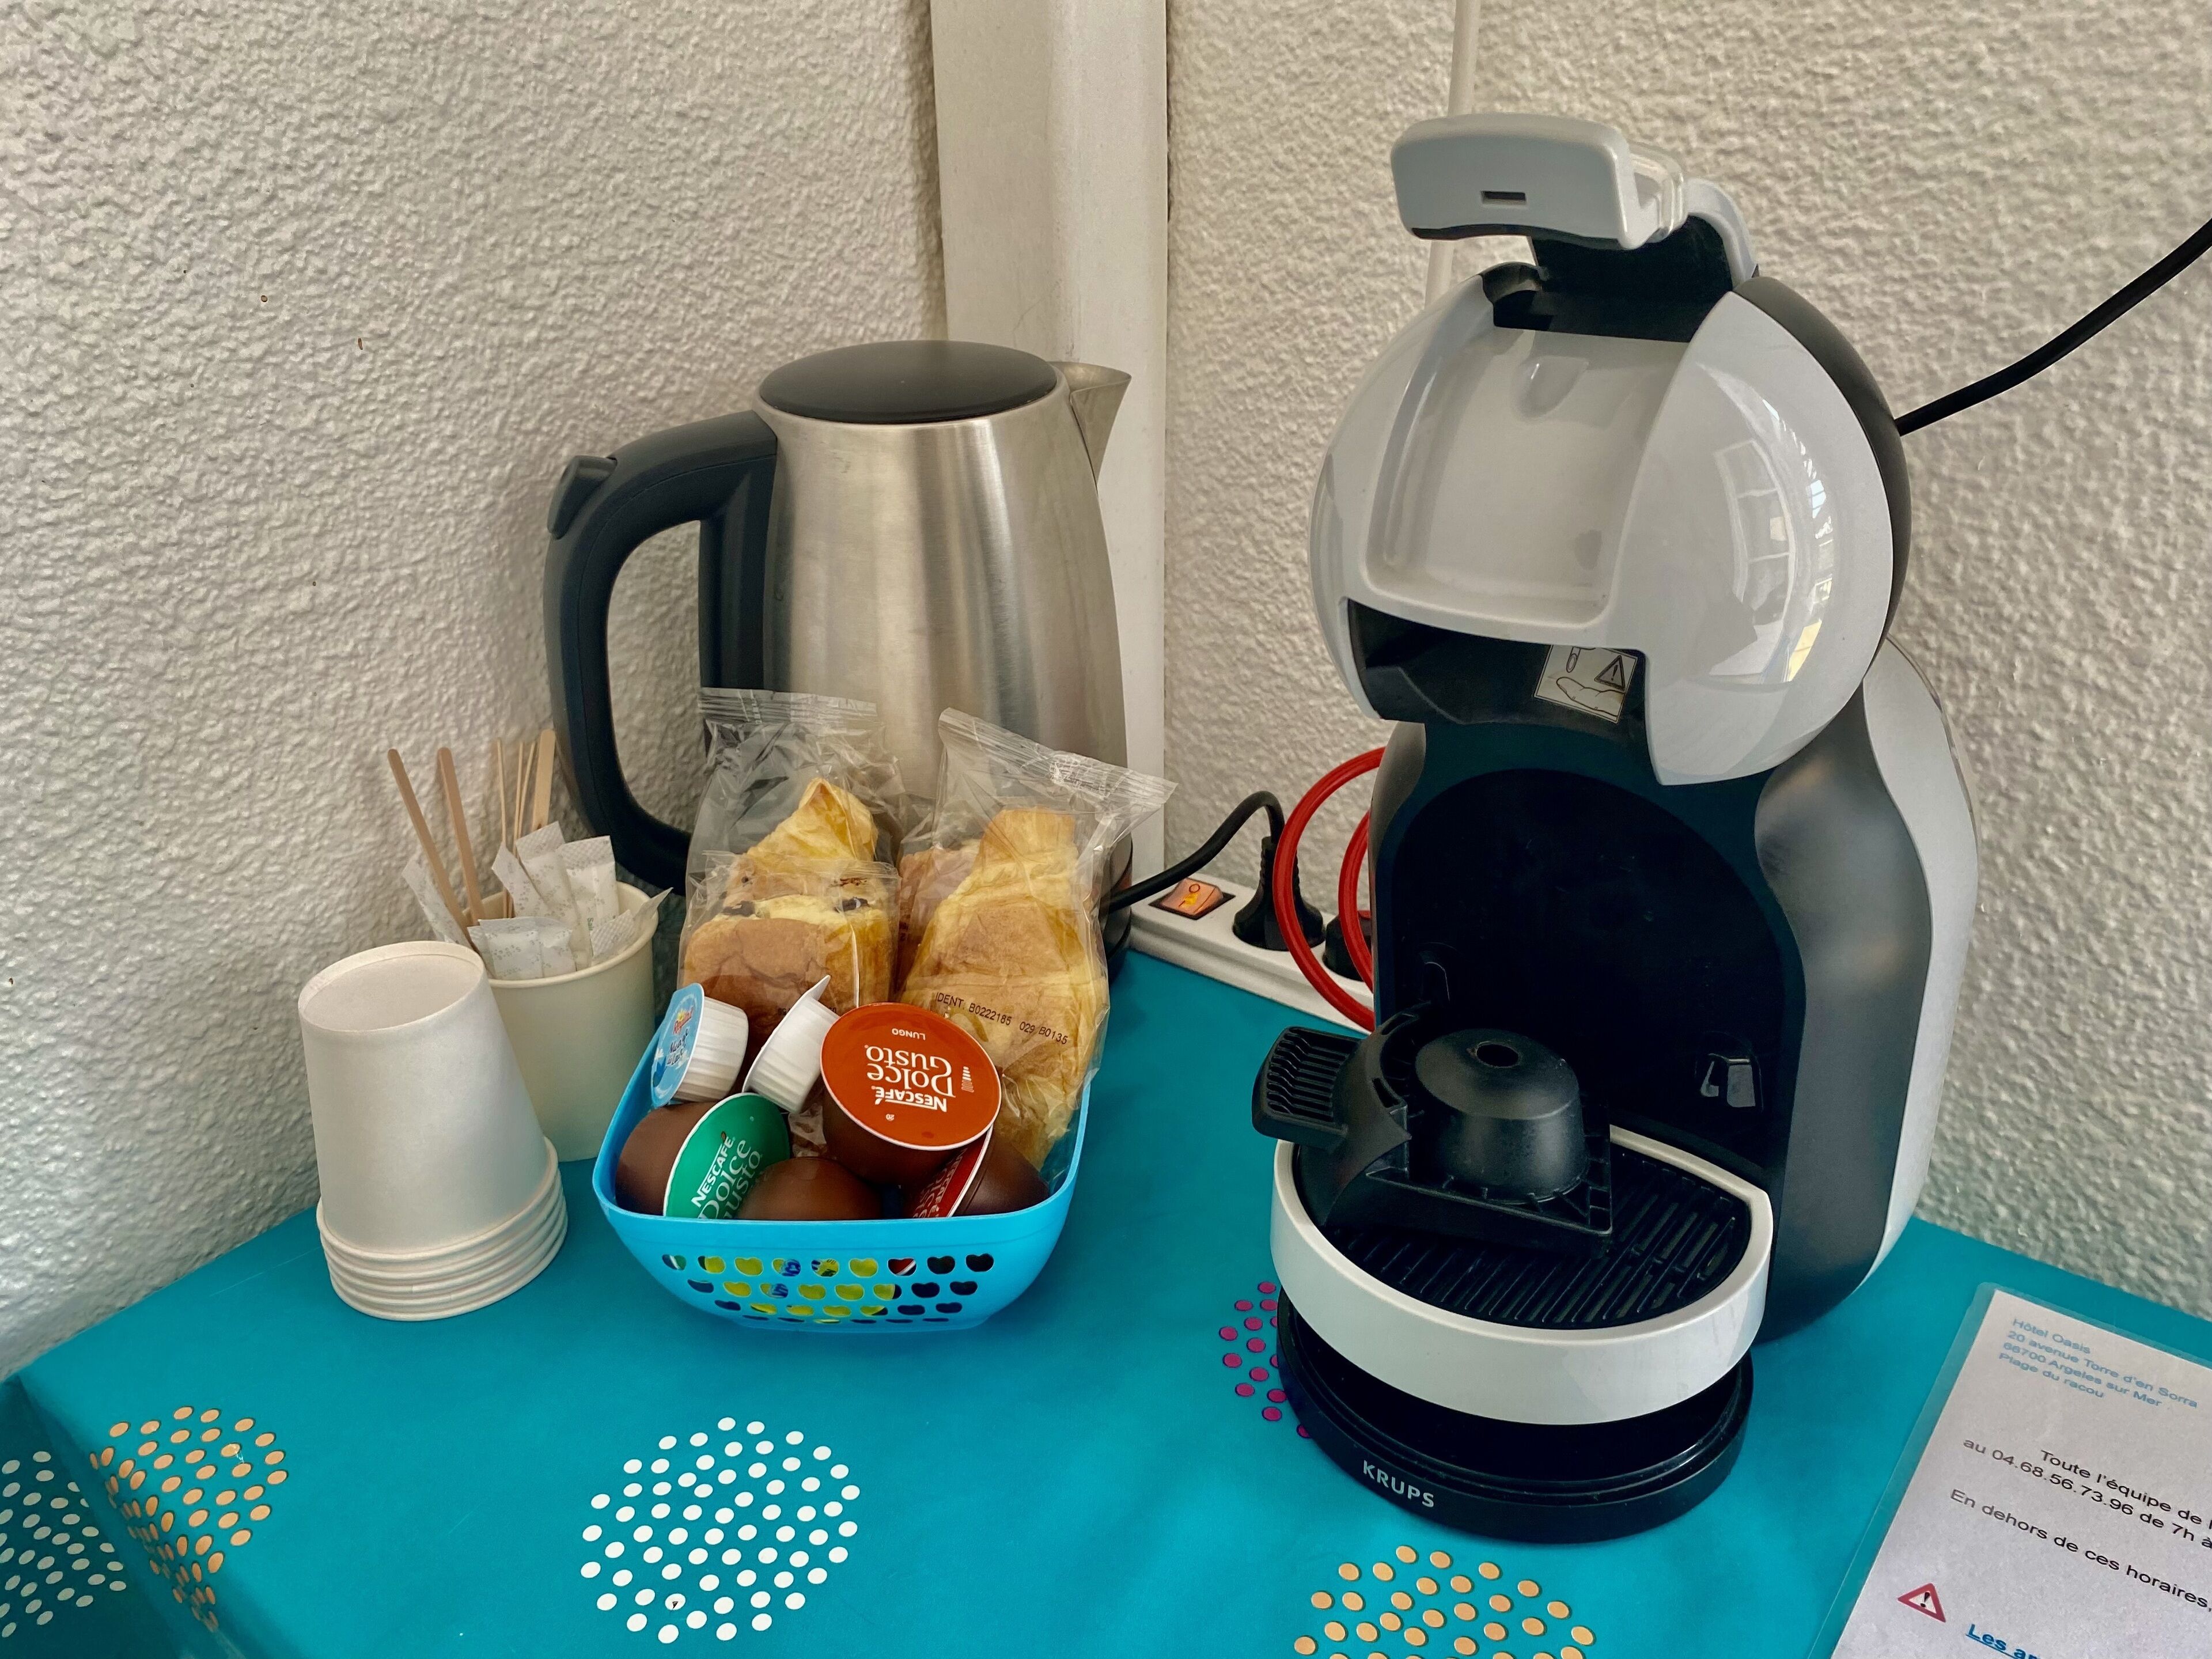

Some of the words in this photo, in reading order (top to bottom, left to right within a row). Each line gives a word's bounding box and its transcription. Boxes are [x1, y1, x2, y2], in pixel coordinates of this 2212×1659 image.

[892, 1028, 926, 1040] LUNGO
[968, 1002, 1012, 1026] B0222185
[1019, 1021, 1036, 1033] 029
[1039, 1027, 1069, 1045] B0135
[865, 1046, 952, 1077] Gusto
[867, 1063, 956, 1098] Dolce
[874, 1086, 947, 1112] NESCAFÉ
[723, 1151, 760, 1218] usto
[2013, 1319, 2048, 1338] Hôtel
[2052, 1334, 2090, 1354] Oasis
[1999, 1353, 2038, 1372] Plage
[2043, 1370, 2060, 1381] du
[2064, 1379, 2104, 1397] racou
[2003, 1342, 2046, 1363] 66700
[2106, 1382, 2130, 1394] sur
[2133, 1391, 2162, 1406] Mer
[2008, 1331, 2025, 1343] 20
[2029, 1340, 2078, 1363] avenue
[2084, 1358, 2119, 1377] Torre
[2158, 1387, 2198, 1408] Sorra
[1363, 1460, 1434, 1508] KRUPS
[1963, 1440, 1986, 1453] au
[1993, 1450, 2134, 1515] 04.68.56.73.96
[2140, 1513, 2164, 1528] de
[2172, 1522, 2194, 1541] 7h
[2041, 1449, 2090, 1478] Toute
[2177, 1510, 2202, 1525] de
[1950, 1488, 1976, 1508] En
[1982, 1505, 2047, 1539] dehors
[2054, 1537, 2078, 1552] de
[2085, 1550, 2119, 1570] ces
[2126, 1565, 2211, 1612] horaires,
[1968, 1624, 2006, 1651] Les
